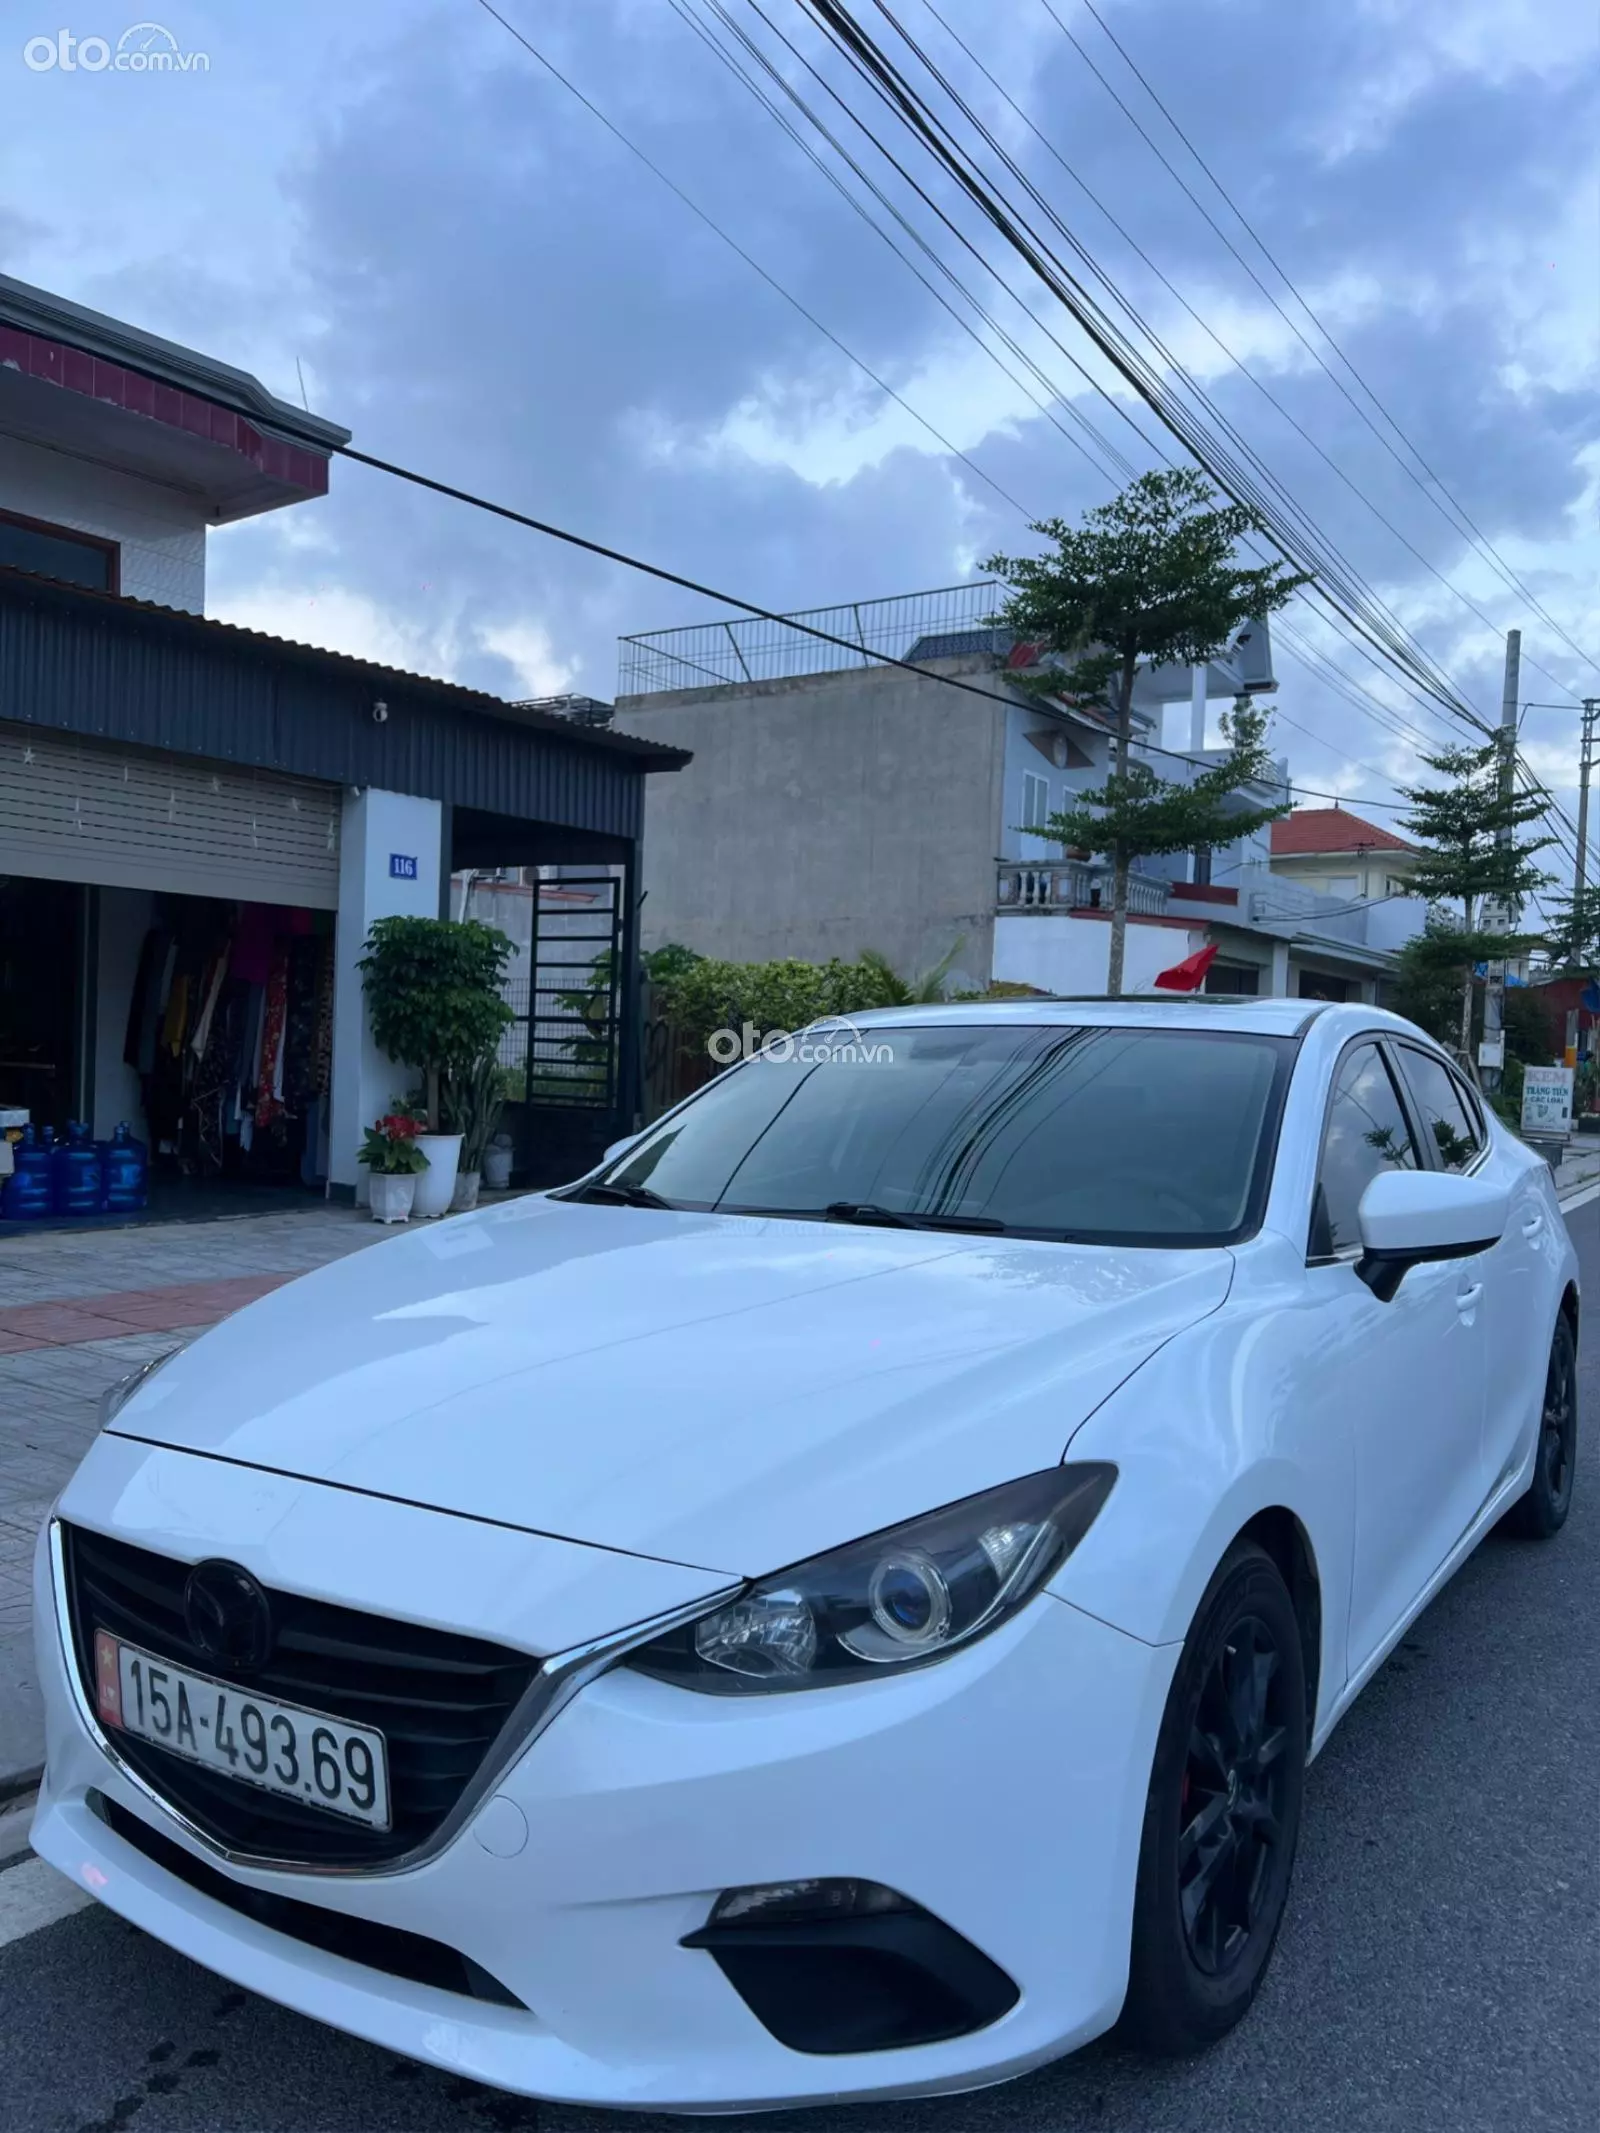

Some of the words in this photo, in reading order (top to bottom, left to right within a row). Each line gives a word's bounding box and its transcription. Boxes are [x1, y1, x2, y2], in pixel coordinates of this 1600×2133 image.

[394, 858, 413, 875] 116
[1527, 1071, 1568, 1083] KEM
[131, 1660, 376, 1810] 15A-493.69
